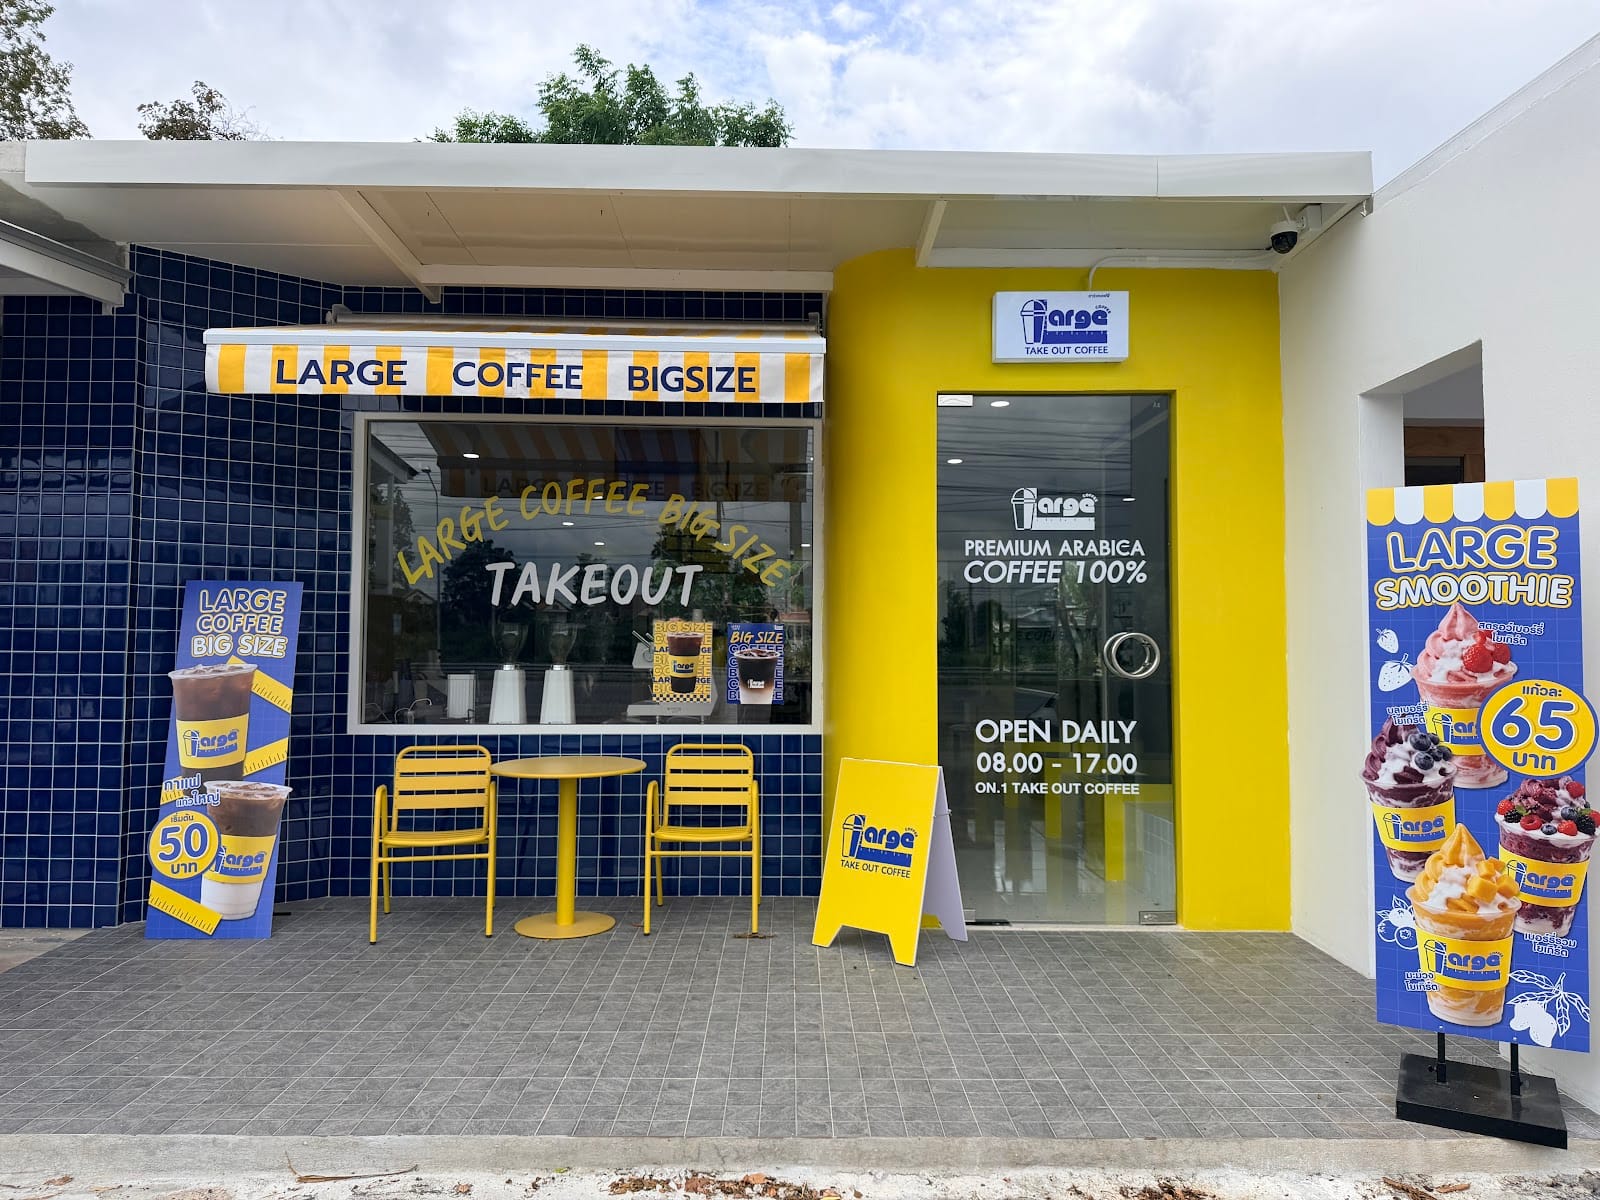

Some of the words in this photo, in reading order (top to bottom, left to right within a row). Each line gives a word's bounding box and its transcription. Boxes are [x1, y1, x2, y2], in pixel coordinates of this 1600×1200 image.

[1025, 346, 1049, 355] TAKE
[1051, 346, 1072, 354] OUT
[1074, 345, 1109, 354] COFFEE
[276, 358, 408, 386] LARGE
[452, 360, 583, 390] COFFEE
[627, 364, 757, 393] BIGSIZE
[397, 495, 508, 586] LARGE
[520, 478, 649, 520] COFFEE
[658, 493, 721, 542] BIG
[713, 524, 792, 587] SIZE
[964, 539, 1052, 556] PREMIUM
[1058, 539, 1146, 557] ARABICA
[1387, 524, 1560, 573] LARGE
[963, 560, 1063, 584] COFFEE
[1075, 560, 1148, 584] 100%
[485, 561, 704, 608] TAKEOUT
[1374, 572, 1574, 609] SMOOTHIE
[199, 588, 287, 615] LARGE
[196, 613, 284, 636] COFFEE
[655, 622, 678, 633] BIG
[682, 622, 712, 633] SIZE
[191, 635, 233, 658] BIG
[236, 634, 289, 658] SIZE
[730, 631, 755, 644] BIG
[755, 631, 784, 644] SIZE
[1522, 683, 1562, 697] แก้วละ
[975, 719, 1051, 743] OPEN
[1062, 720, 1138, 744] DAILY
[1490, 696, 1576, 751] 65
[976, 752, 1043, 774] 08.00
[1072, 752, 1138, 774] 17.00
[1512, 751, 1557, 771] บาท
[163, 773, 202, 791] กาแฟ
[975, 782, 1008, 794] ON.1
[1011, 782, 1049, 794] TAKE
[1051, 782, 1082, 795] OUT
[1084, 783, 1140, 795] COFFEE
[175, 789, 221, 808] แก้วใหญ่
[170, 812, 195, 823] เริ่มต้น
[157, 821, 210, 863] 50
[170, 861, 198, 875] บาท
[840, 859, 861, 870] TAKE
[861, 863, 880, 873] OUT
[881, 866, 911, 879] COFFEE
